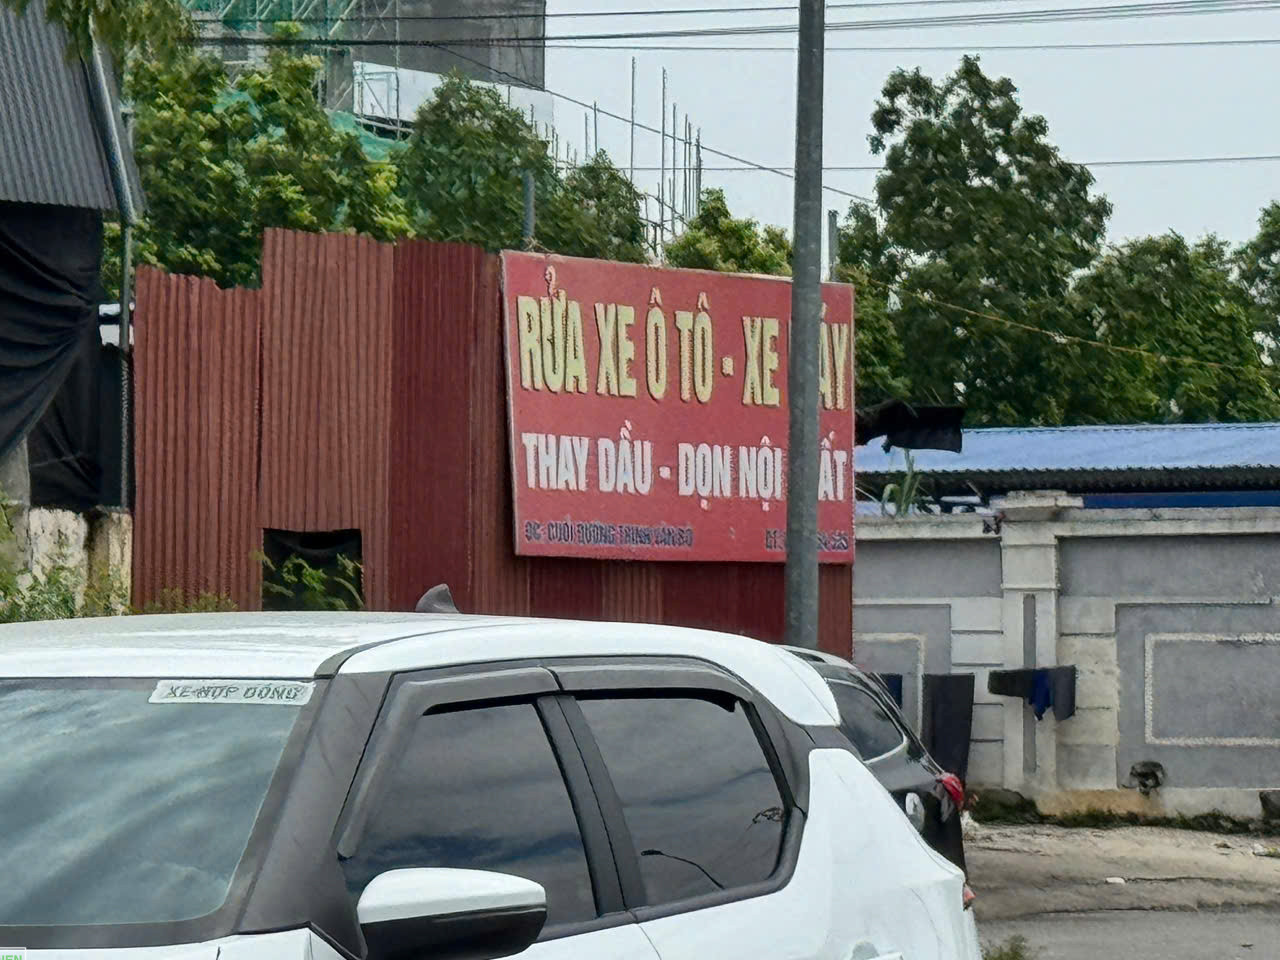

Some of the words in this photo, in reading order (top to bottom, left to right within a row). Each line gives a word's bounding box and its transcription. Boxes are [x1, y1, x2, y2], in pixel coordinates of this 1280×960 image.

[517, 265, 588, 394] RỬA
[594, 302, 637, 398] XE
[646, 287, 667, 400] Ô
[674, 292, 714, 403] TÔ
[742, 316, 780, 407] XE
[521, 432, 589, 492] THAY
[597, 419, 653, 496] DẦU
[678, 442, 732, 511] DỌN
[739, 435, 783, 512] NỘI
